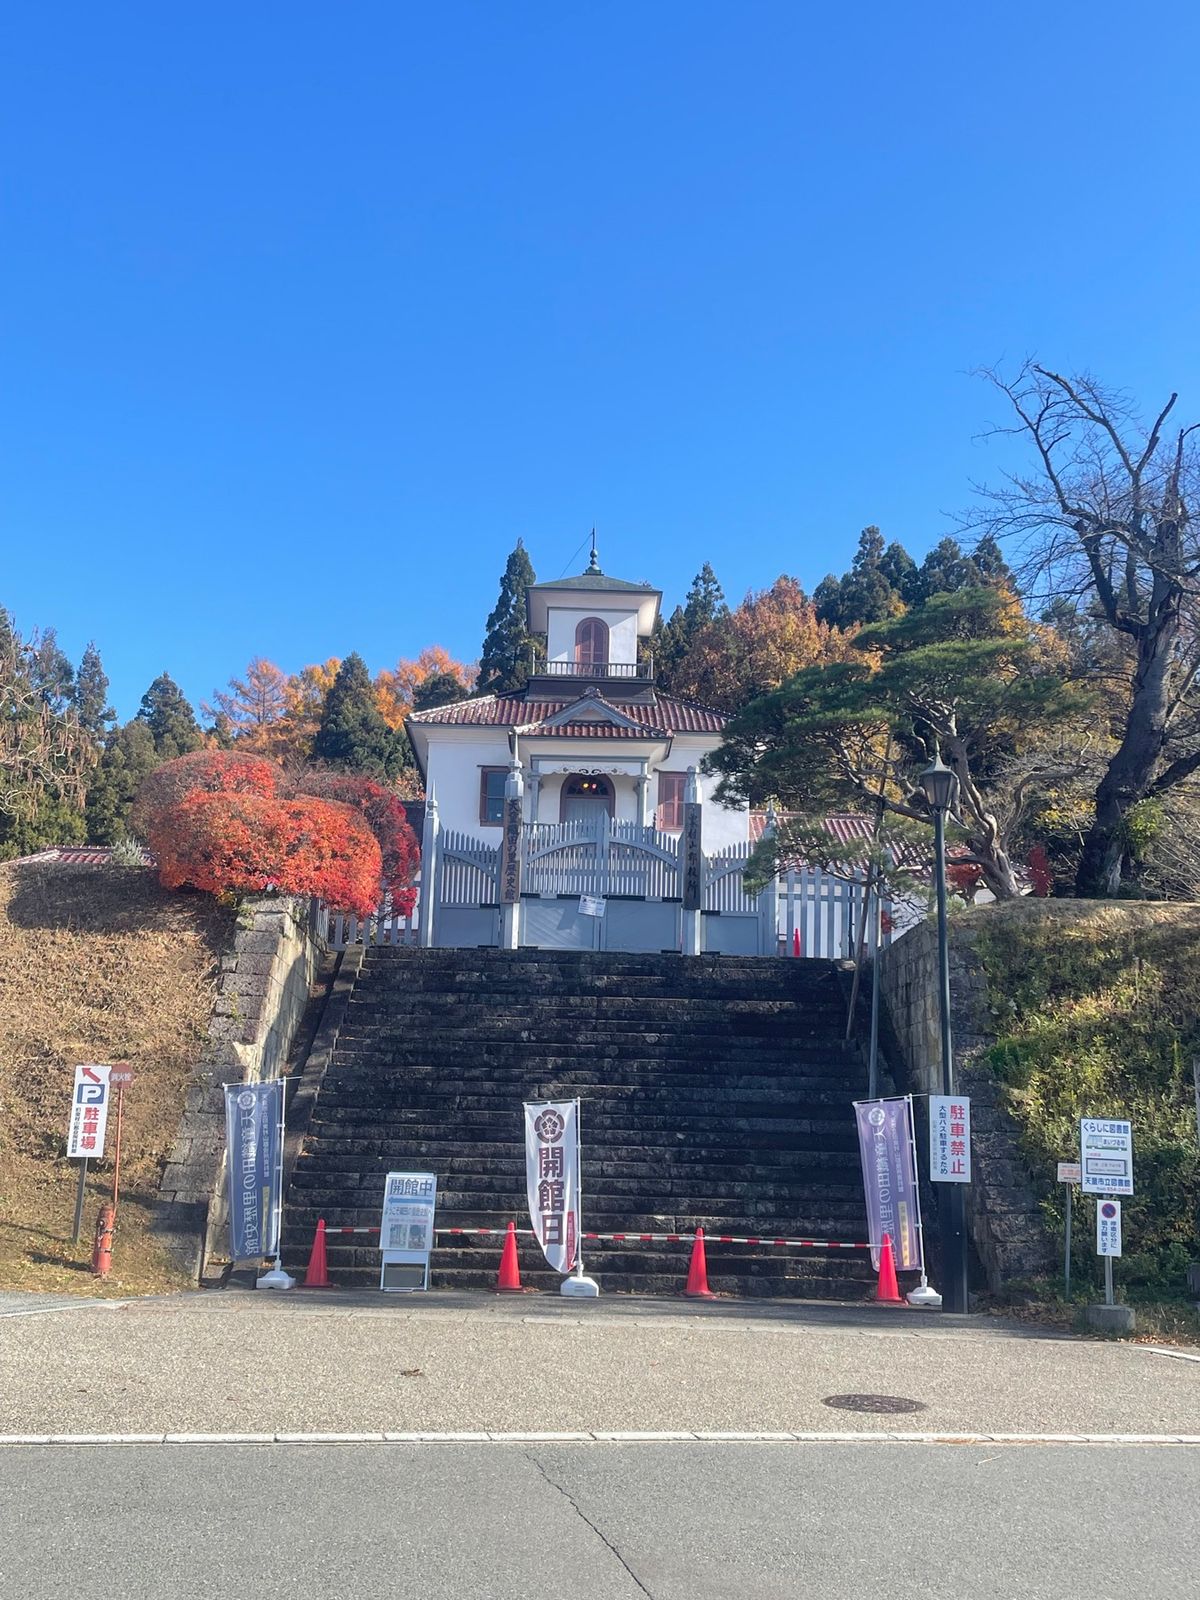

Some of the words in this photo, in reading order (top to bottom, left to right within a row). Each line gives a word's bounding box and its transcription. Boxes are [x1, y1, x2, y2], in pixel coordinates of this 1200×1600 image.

[81, 1085, 102, 1103] P
[80, 1106, 100, 1150] 駐車場
[949, 1104, 966, 1175] 駐車禁止
[1083, 1122, 1129, 1134] くらしに図書館
[389, 1178, 433, 1197] 開館中
[538, 1146, 565, 1246] 開館日
